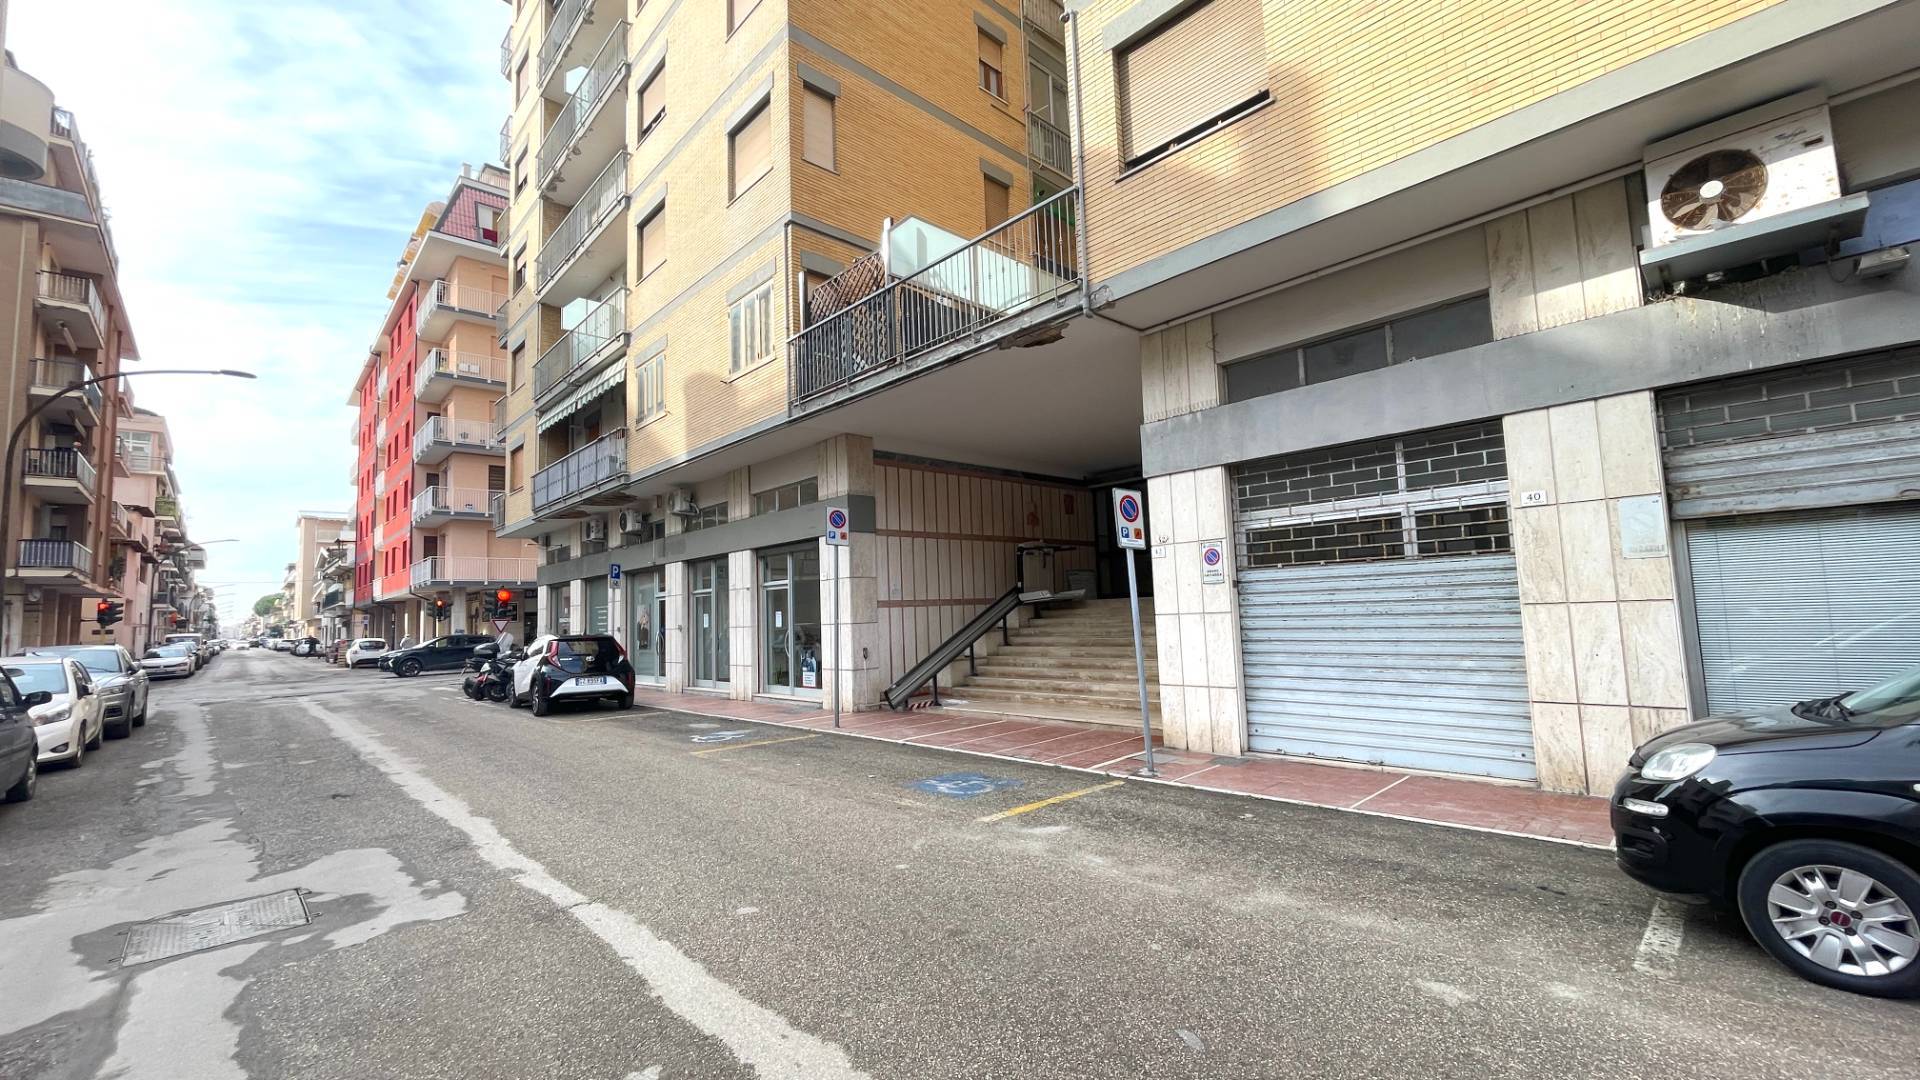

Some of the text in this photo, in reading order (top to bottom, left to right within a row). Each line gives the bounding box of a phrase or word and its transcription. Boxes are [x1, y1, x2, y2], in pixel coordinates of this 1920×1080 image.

[1526, 492, 1541, 501] 40
[1122, 528, 1128, 537] P
[612, 565, 619, 577] P
